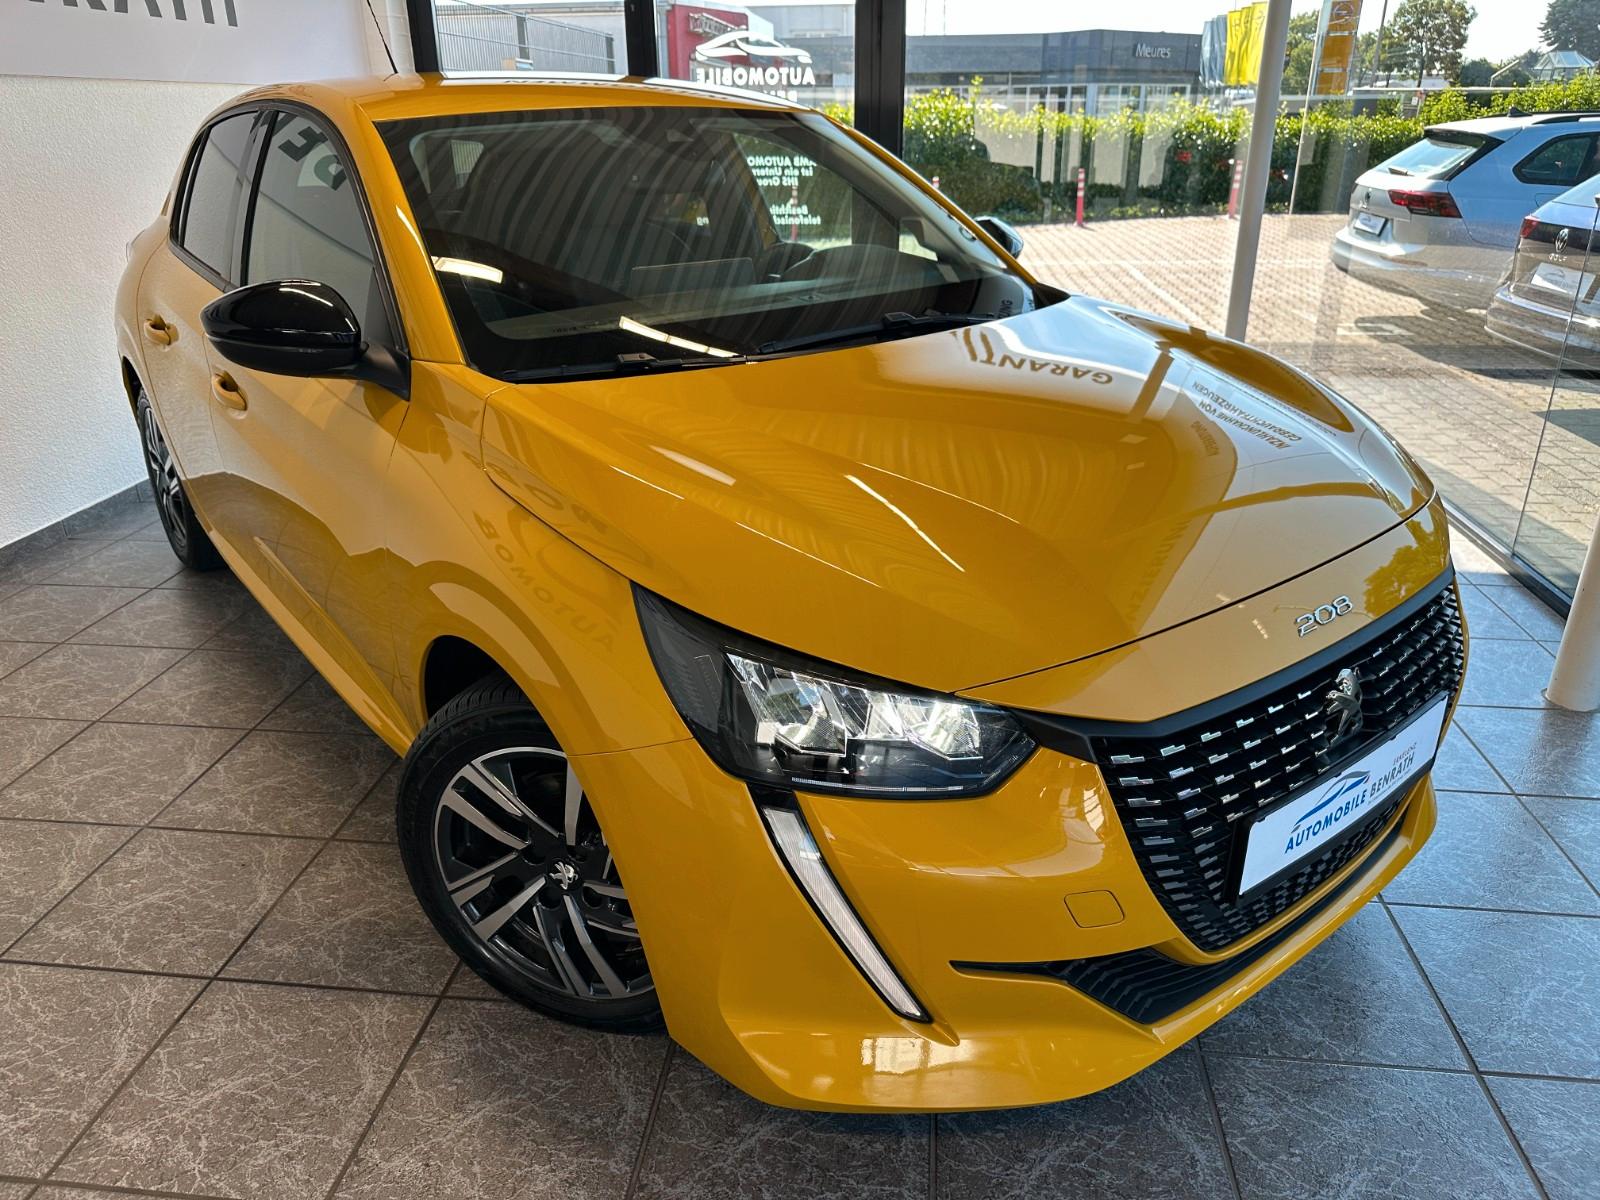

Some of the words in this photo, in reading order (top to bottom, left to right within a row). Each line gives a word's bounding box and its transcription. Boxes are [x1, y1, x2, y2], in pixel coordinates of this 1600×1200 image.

[1135, 42, 1171, 59] Meures
[949, 328, 1113, 385] GARANTI
[1295, 595, 1355, 637] 208
[1284, 788, 1368, 854] AUTOMOBILE
[1369, 751, 1415, 798] BENRATH
